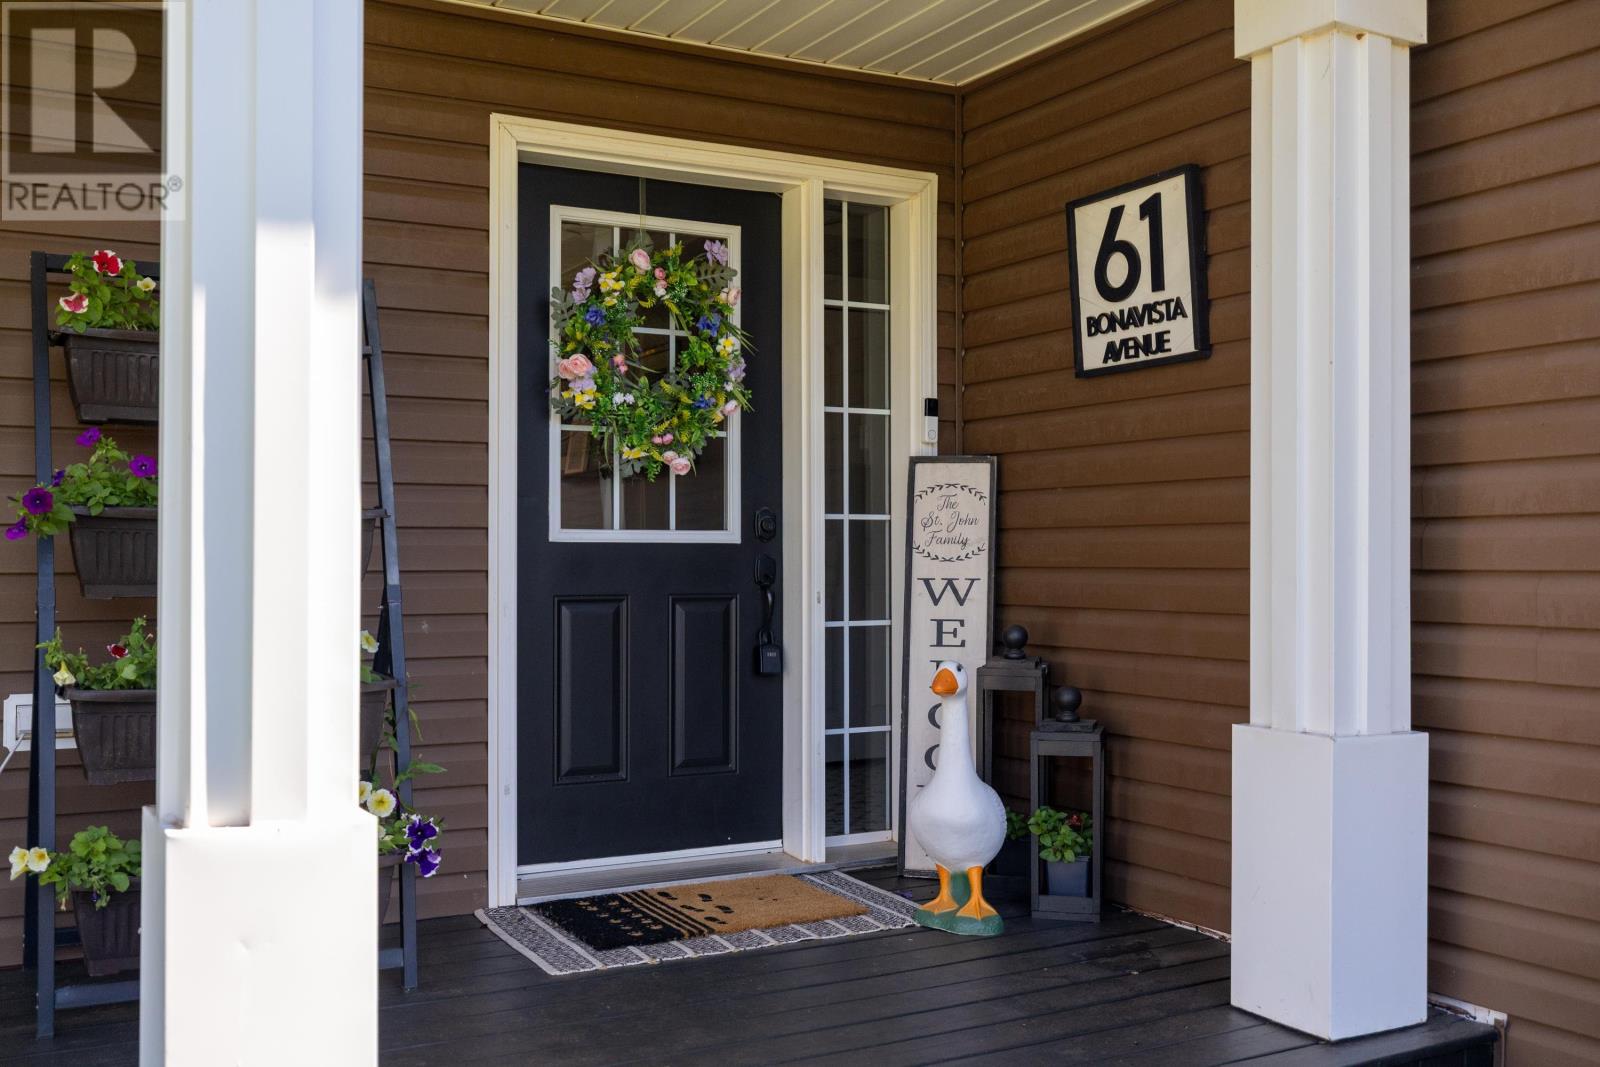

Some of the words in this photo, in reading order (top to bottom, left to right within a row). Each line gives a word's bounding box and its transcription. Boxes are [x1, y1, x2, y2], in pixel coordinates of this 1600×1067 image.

[1094, 192, 1165, 303] 61
[1086, 296, 1188, 337] BONAVISTA
[1102, 330, 1172, 364] AVENUE
[936, 493, 959, 511] The
[920, 511, 943, 532] St.
[946, 511, 979, 533] John
[924, 529, 969, 550] Family
